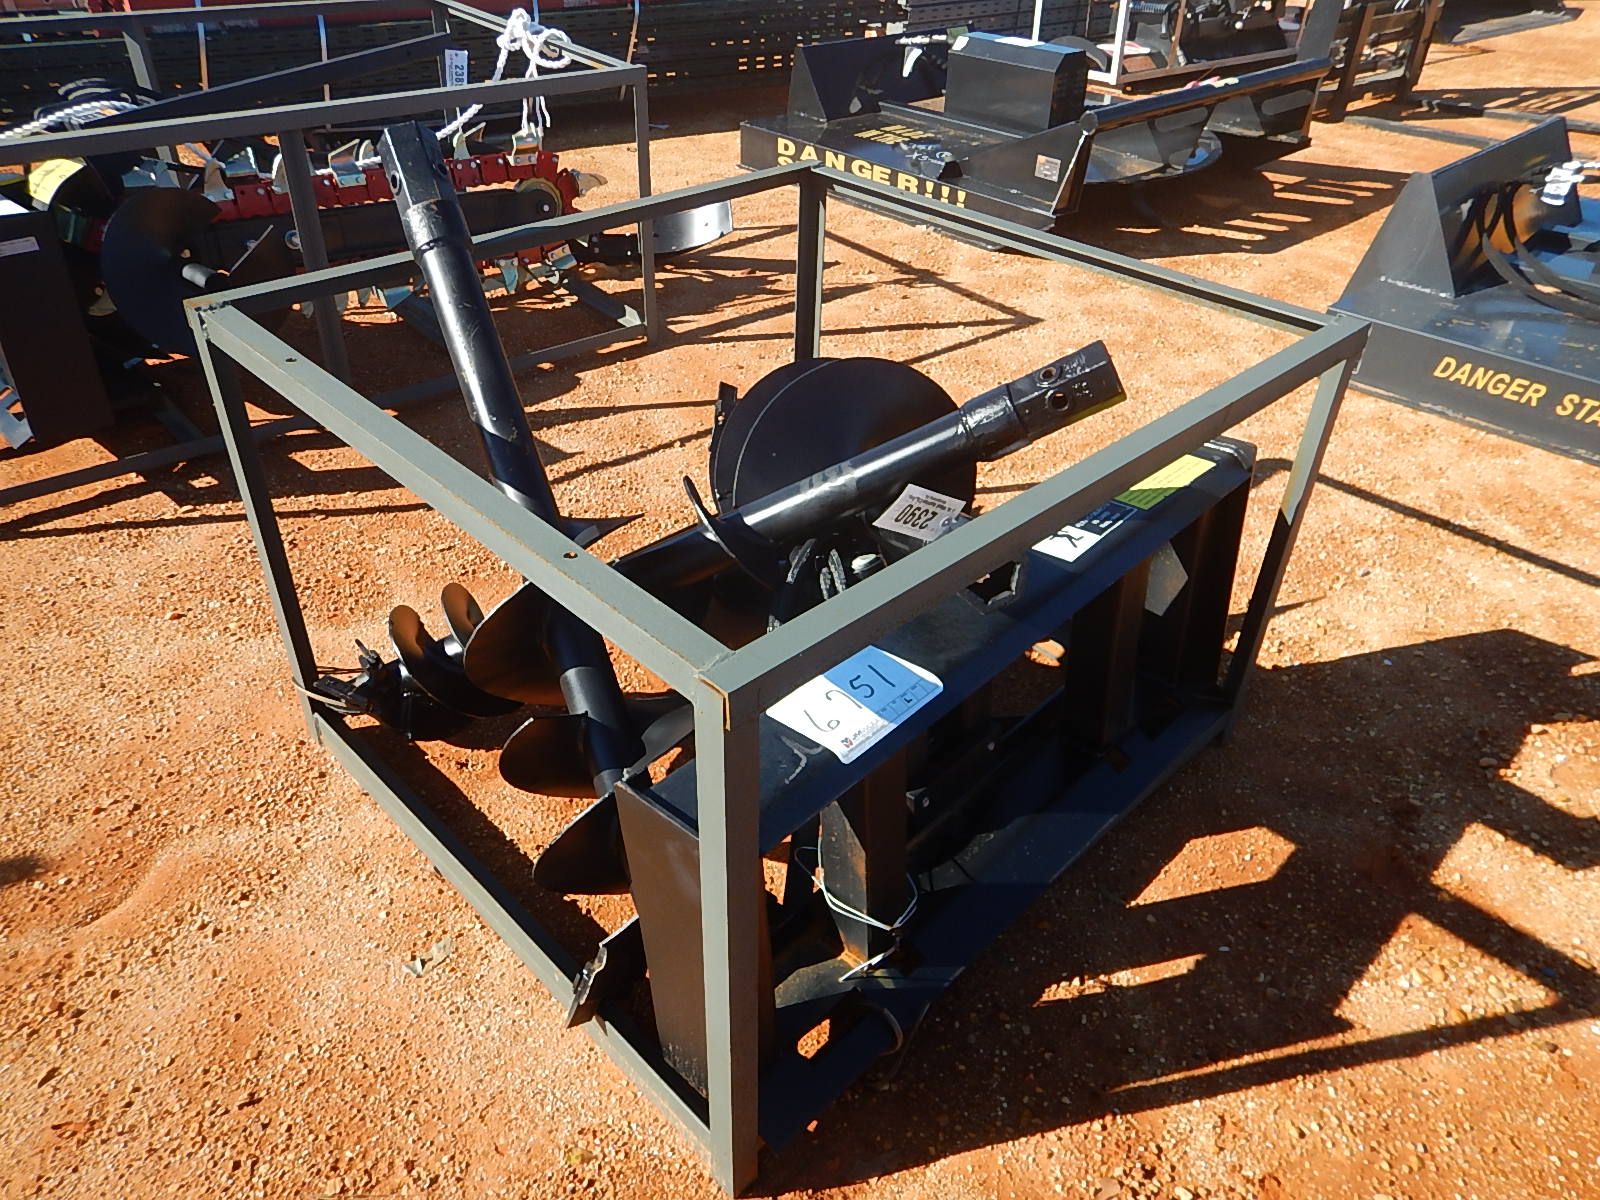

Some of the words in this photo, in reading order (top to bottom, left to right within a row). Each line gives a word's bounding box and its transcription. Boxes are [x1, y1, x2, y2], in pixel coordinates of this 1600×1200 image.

[777, 137, 967, 208] DANGER!!!
[1433, 356, 1547, 407] DANGER
[894, 503, 938, 530] 2390
